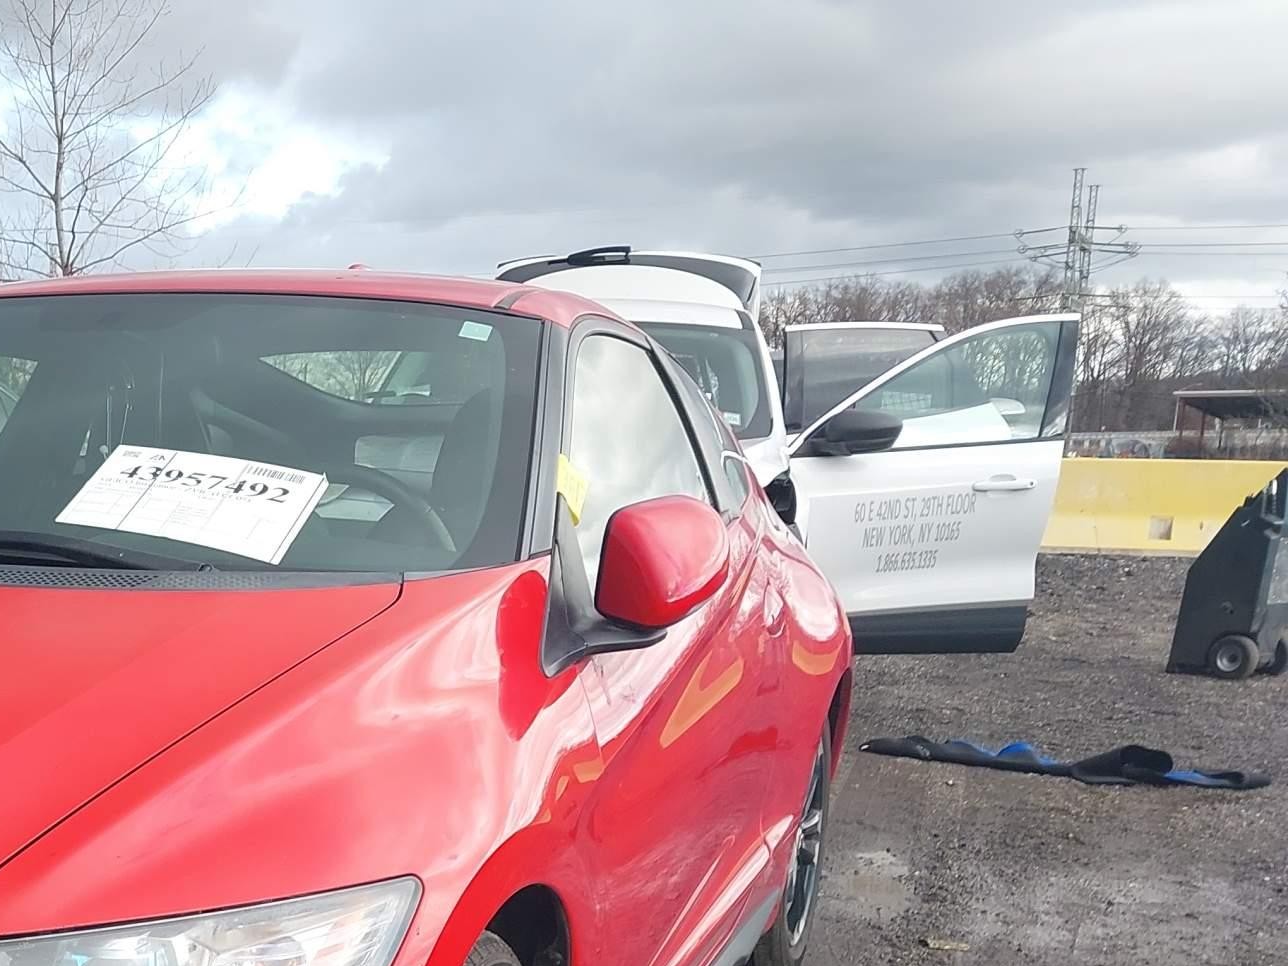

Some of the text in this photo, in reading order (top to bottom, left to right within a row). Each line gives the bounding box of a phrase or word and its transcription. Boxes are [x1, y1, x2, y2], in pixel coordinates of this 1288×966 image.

[120, 465, 290, 503] 43957492
[854, 502, 866, 523] 60
[868, 501, 874, 521] E
[876, 498, 902, 520] 42ND
[920, 495, 944, 517] 29TH
[945, 492, 977, 515] FLOOR
[862, 521, 962, 548] NEW YORK, NY 10165
